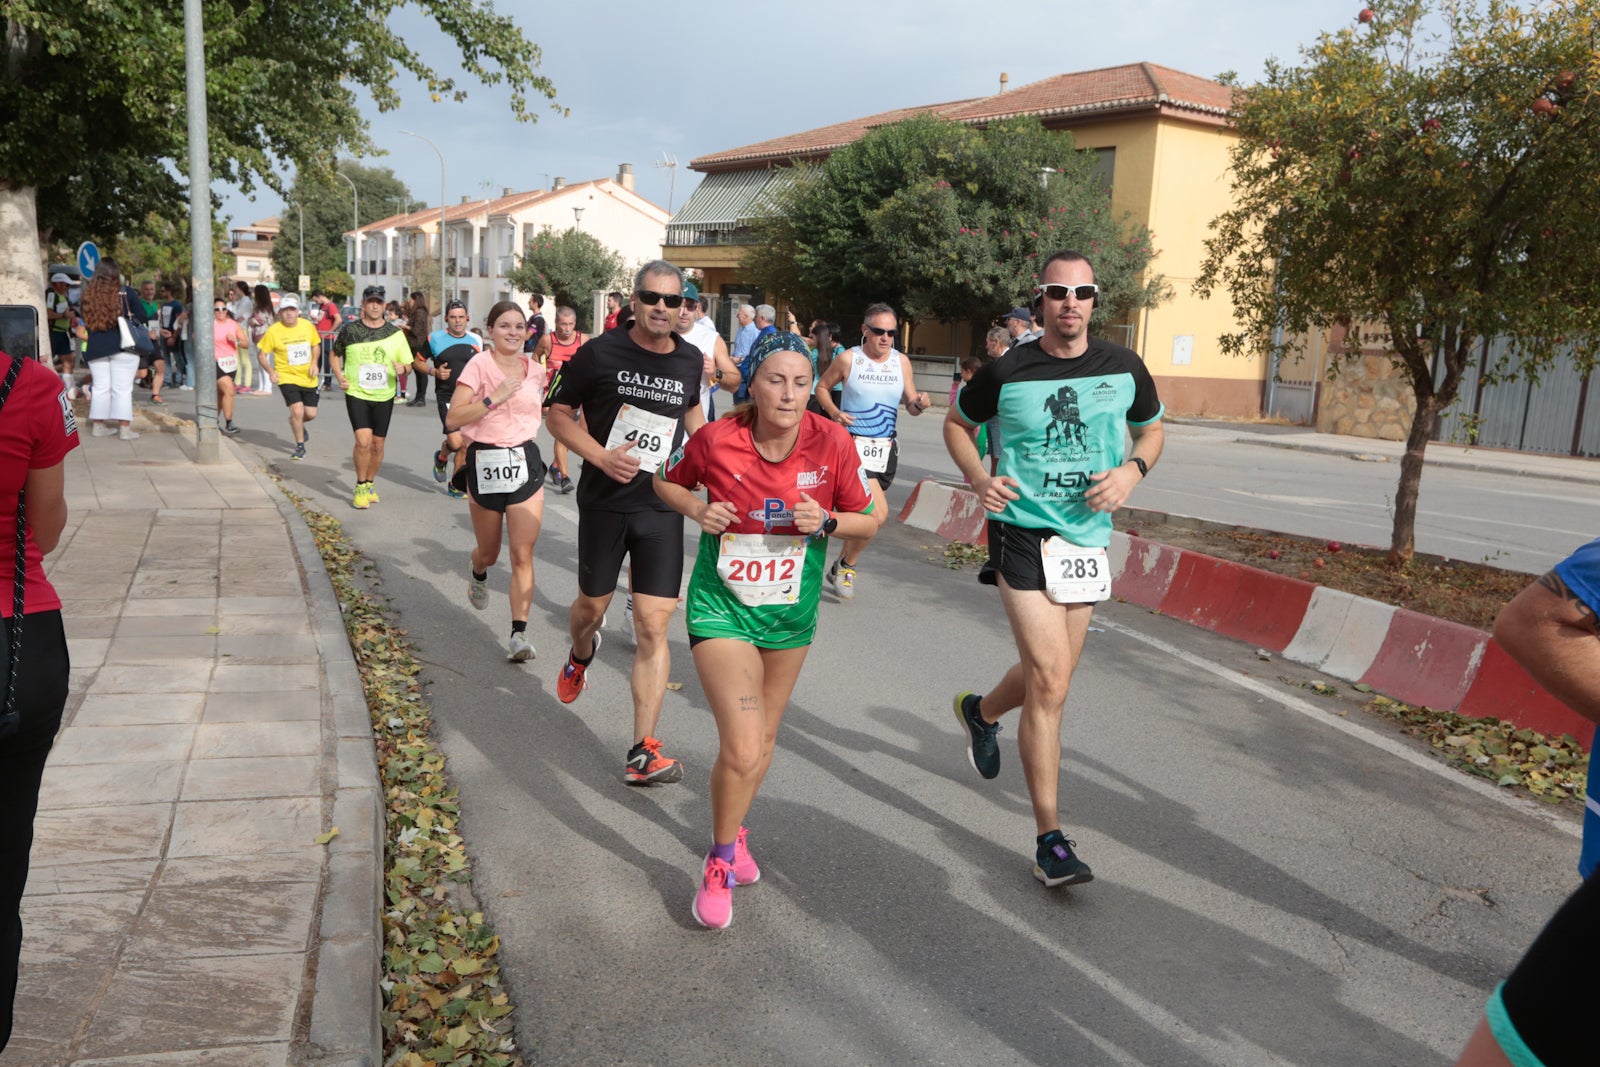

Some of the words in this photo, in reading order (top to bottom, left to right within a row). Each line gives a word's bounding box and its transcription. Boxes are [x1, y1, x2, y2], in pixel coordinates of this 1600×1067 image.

[294, 350, 307, 359] 256
[366, 372, 383, 381] 289
[617, 370, 685, 394] GALSER
[858, 374, 898, 382] MARACENA
[617, 385, 683, 405] estanterías
[625, 429, 661, 453] 469
[863, 446, 883, 458] 861
[482, 465, 521, 480] 3107
[1043, 470, 1093, 488] HSN
[728, 559, 795, 583] 2012
[1060, 558, 1098, 579] 283
